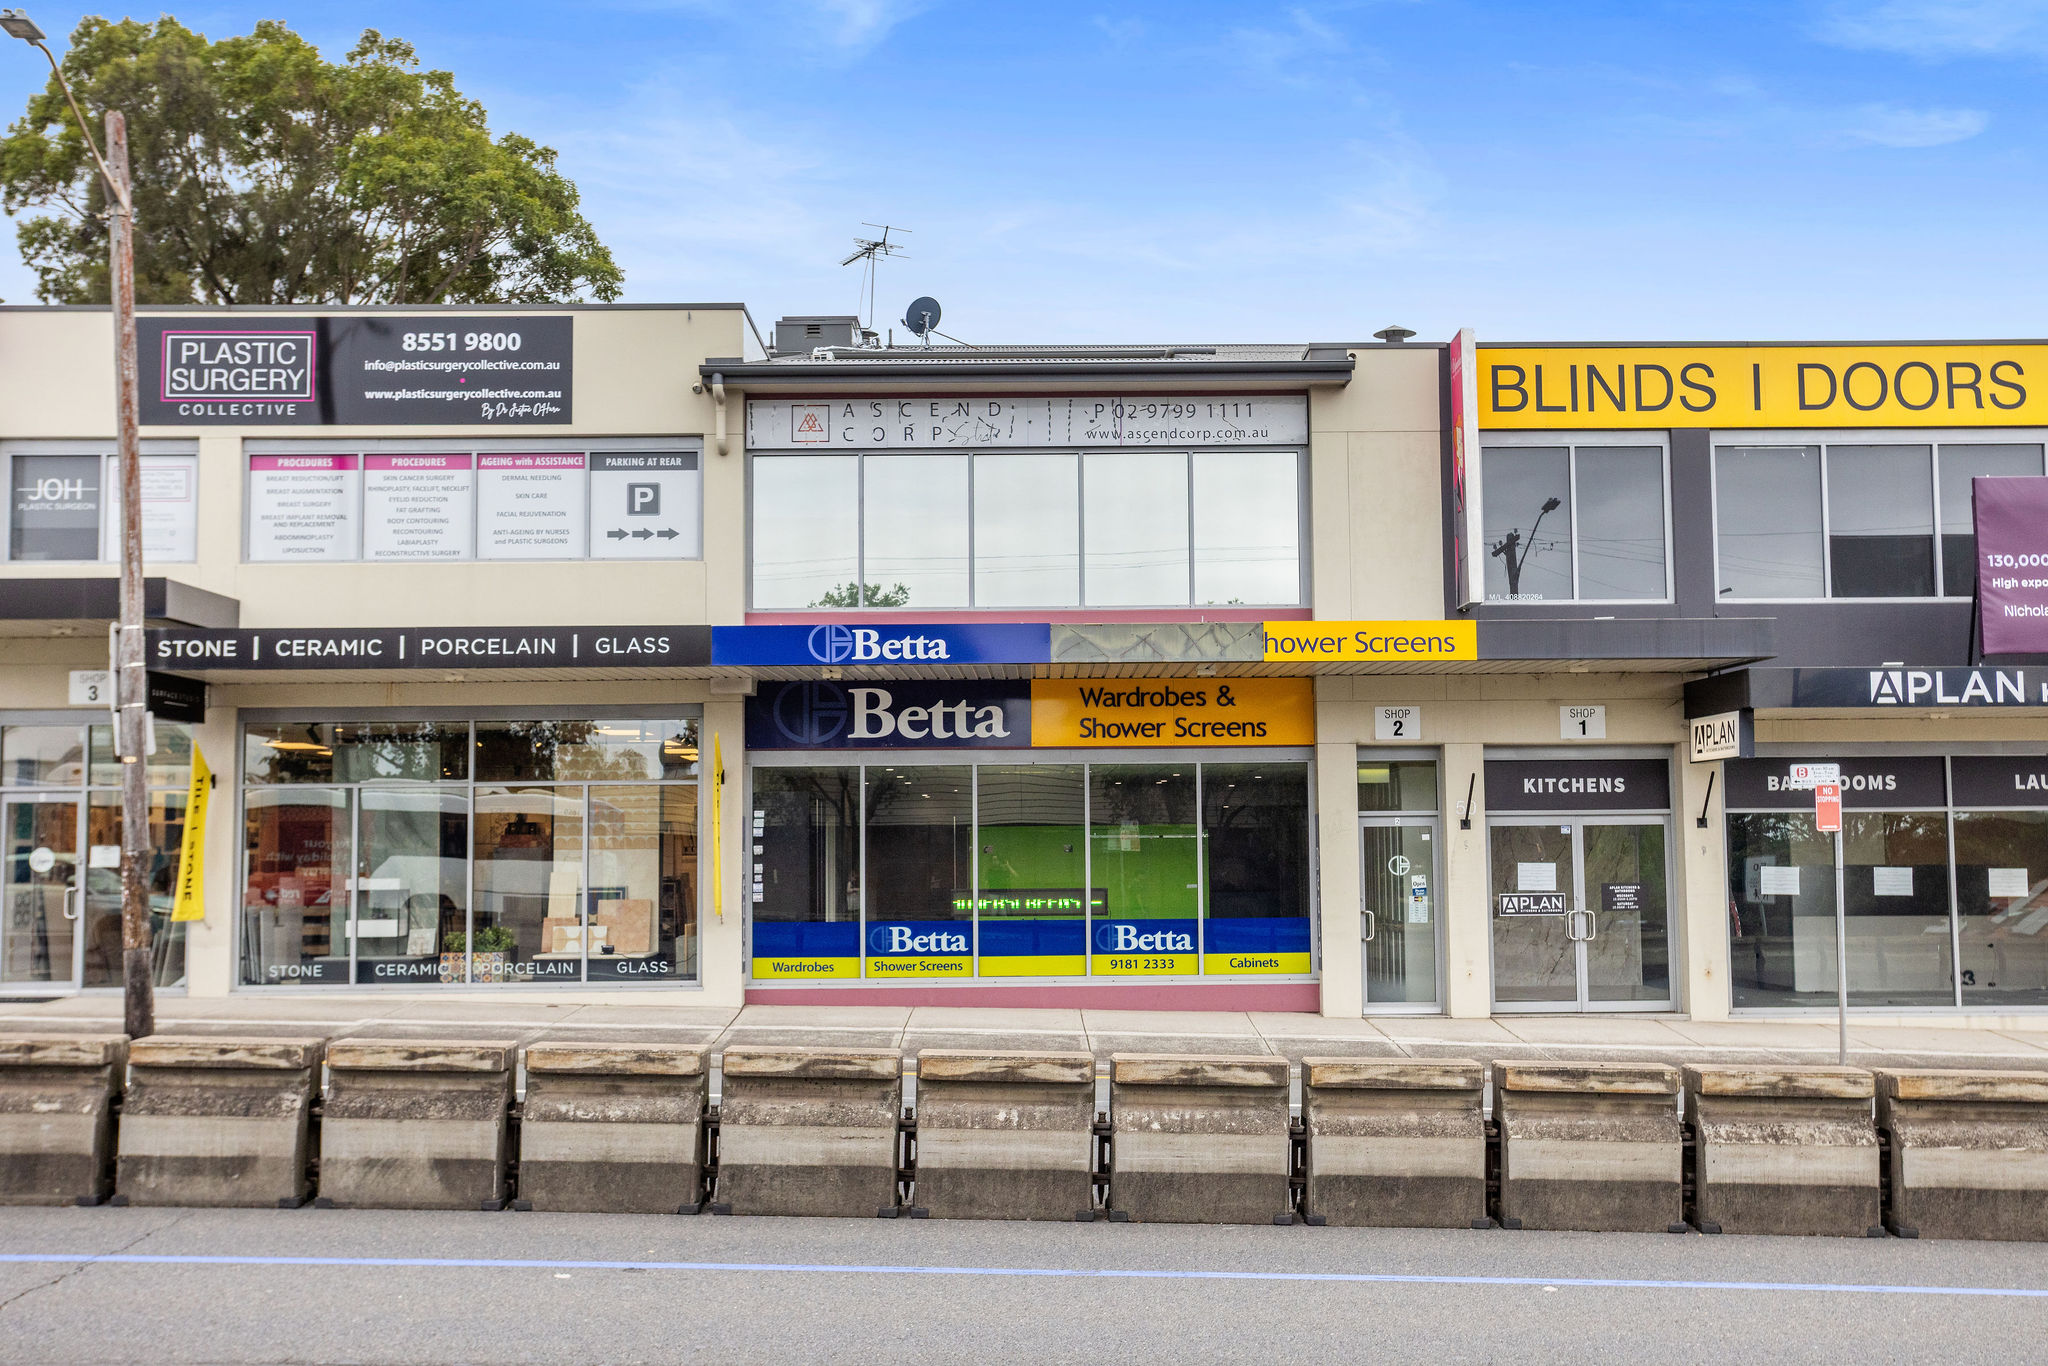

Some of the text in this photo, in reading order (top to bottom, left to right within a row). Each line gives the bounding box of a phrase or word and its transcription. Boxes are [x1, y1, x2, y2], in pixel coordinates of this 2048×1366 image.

[402, 333, 522, 351] 8551 9800
[181, 342, 297, 365] PLASTIC
[364, 359, 560, 372] info@plasticsurgerycollective.com.au
[171, 368, 305, 391] SURGERY
[1490, 363, 1717, 413] BLINDS
[1797, 360, 2028, 412] DOORS
[364, 388, 562, 401] www.plasticsurgerycollective.com.au
[179, 403, 297, 416] COLLECTIVE
[842, 401, 1001, 418] ASCEND
[1114, 403, 1138, 419] 02
[1147, 403, 1197, 419] 9799
[1207, 402, 1254, 418] 1111
[1086, 427, 1269, 441] www.ascendcorp.com.au
[277, 457, 333, 467] PROCEDURES
[391, 457, 447, 467] PROCEDURES
[480, 456, 584, 467] AGEING with ASSISTANCE
[605, 457, 682, 467] PARKING AT REAR
[28, 478, 82, 500] JOH
[17, 503, 53, 511] PLASTIC
[1992, 577, 2019, 590] High
[157, 639, 237, 658] STONE
[275, 639, 383, 658] CERAMIC
[421, 638, 557, 656] PORCELAIN
[595, 636, 671, 655] GLASS
[851, 629, 951, 661] Betta
[1264, 631, 1456, 653] hower Screens
[88, 685, 98, 701] 3
[1080, 685, 1236, 708] Wardrobes &
[847, 687, 1011, 740] Betta
[1384, 708, 1411, 719] SHOP
[1569, 708, 1596, 719] SHOP
[1080, 717, 1267, 739] Shower Screens
[1392, 720, 1404, 737] 2
[1578, 719, 1587, 736] 1
[1523, 777, 1626, 793] KITCHENS
[1822, 787, 1833, 795] NO
[889, 926, 969, 953] Betta
[1114, 925, 1194, 951] Betta
[374, 963, 450, 977] CERAMIC
[480, 962, 574, 975] PORCELAIN
[616, 961, 669, 974] GLASS
[772, 961, 835, 973] Wardrobes
[873, 960, 963, 972] Shower Screens
[1110, 959, 1175, 970] 9181 2333
[1229, 957, 1280, 969] Cabinets
[268, 965, 323, 978] STONE
